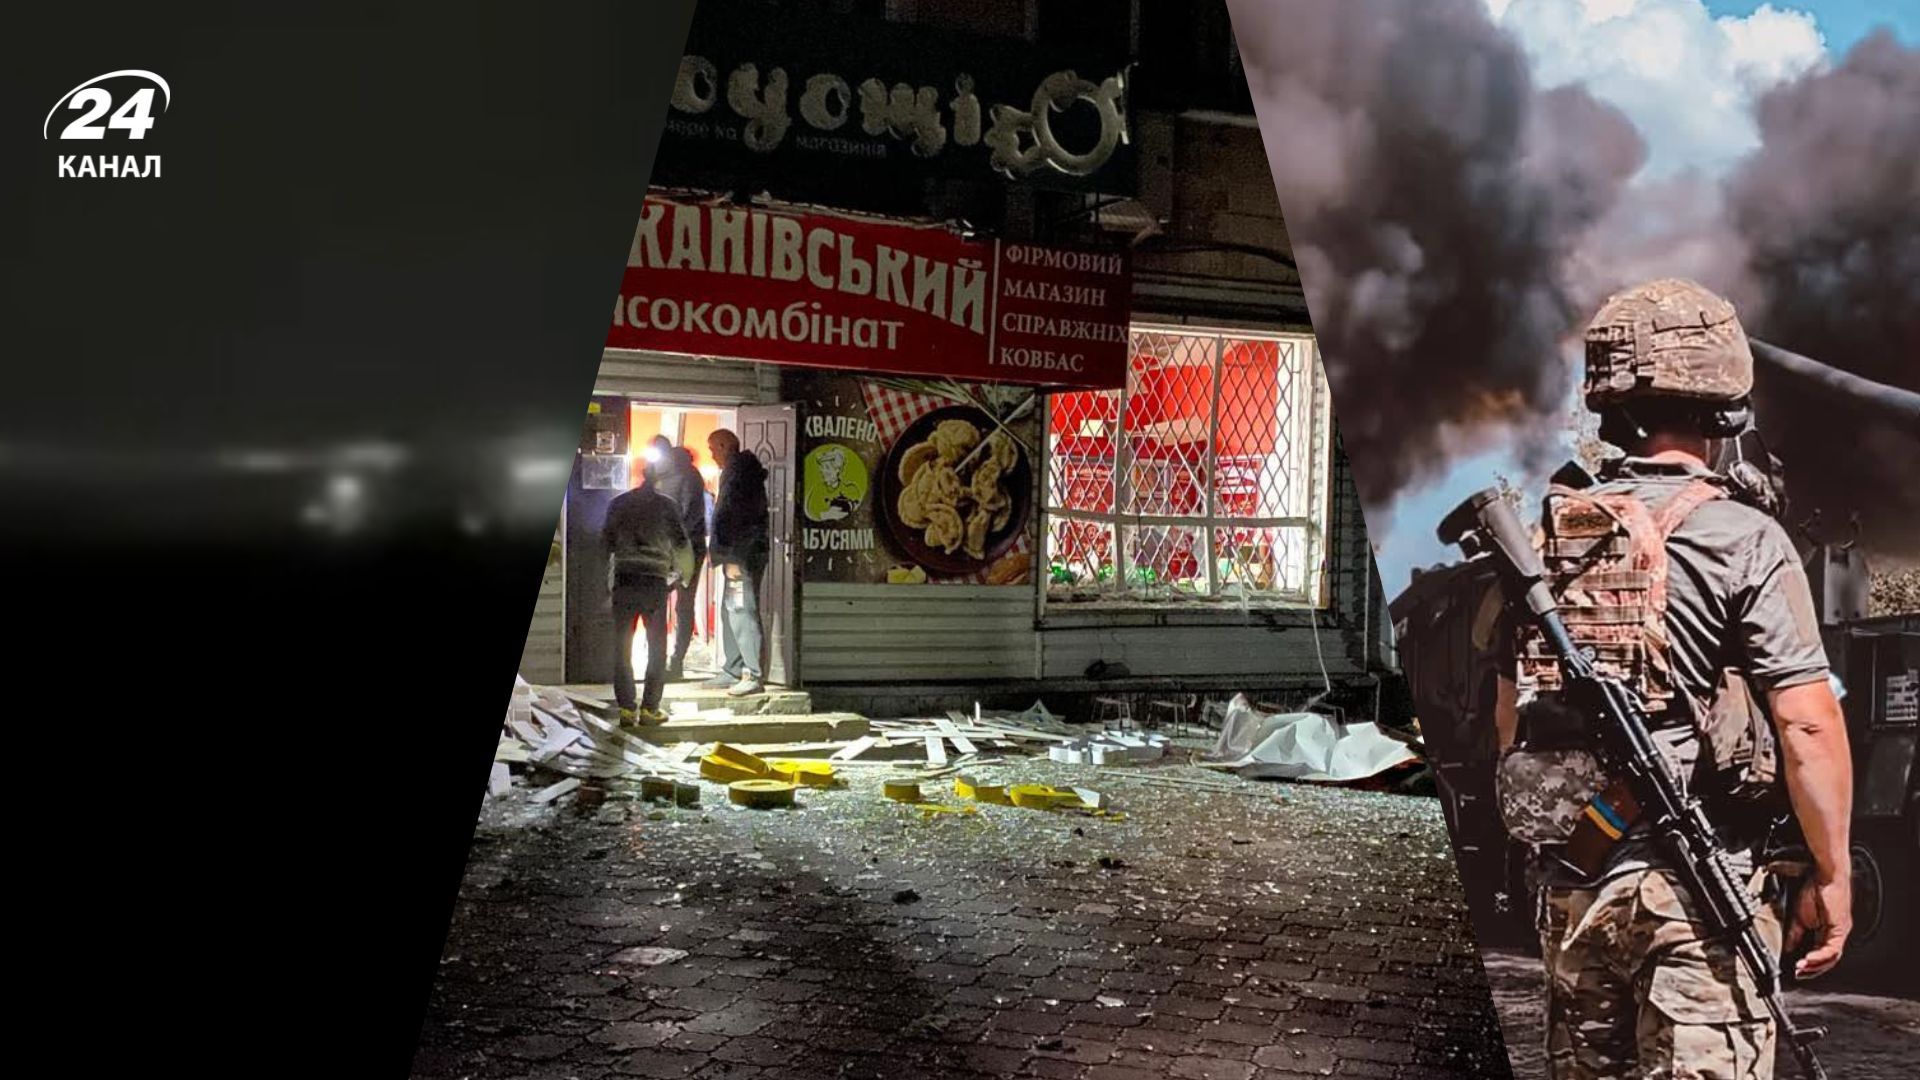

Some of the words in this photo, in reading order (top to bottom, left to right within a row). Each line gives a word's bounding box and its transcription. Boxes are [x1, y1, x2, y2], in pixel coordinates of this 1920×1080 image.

[1005, 245, 1122, 275] ФІРМОВИЙ
[1003, 278, 1106, 307] МАГАЗИН
[1002, 312, 1129, 343] СПРАВЖНІХ
[1000, 346, 1084, 372] КОВБАС
